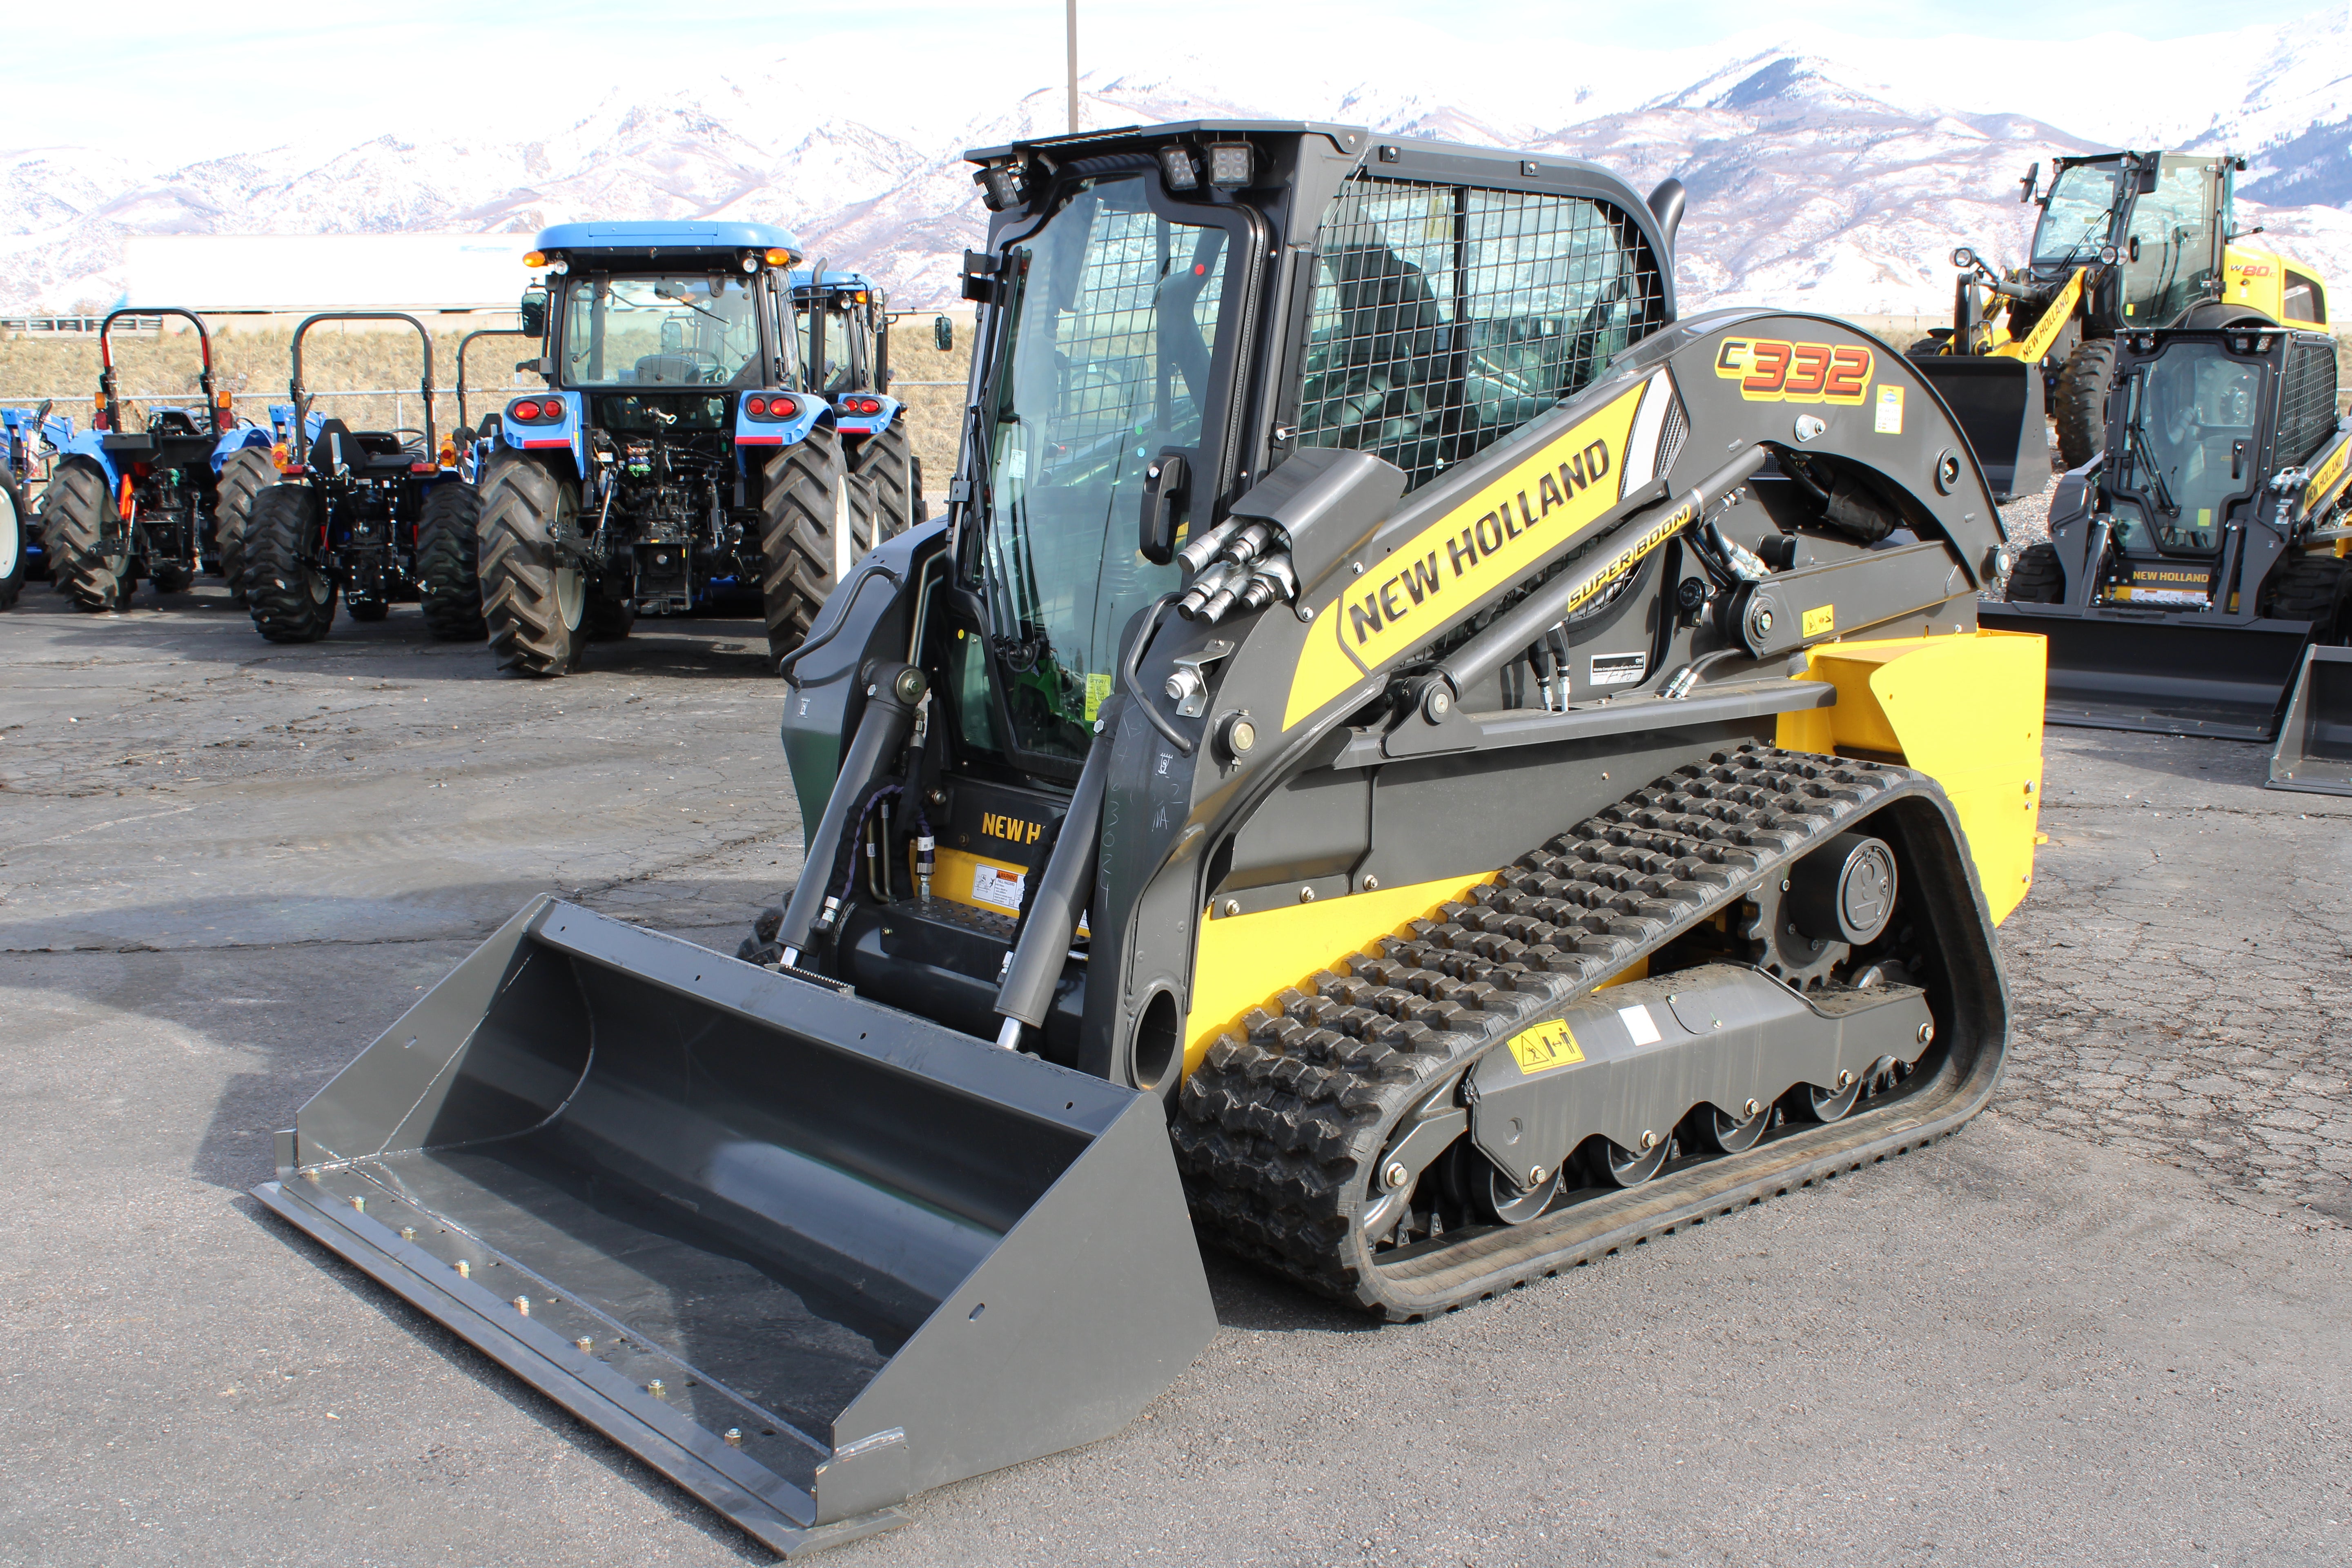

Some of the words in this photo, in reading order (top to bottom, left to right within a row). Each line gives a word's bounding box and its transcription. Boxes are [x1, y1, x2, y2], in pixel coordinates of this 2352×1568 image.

[2022, 332, 2038, 361] NEW
[2039, 291, 2069, 339] HOLLAND
[1716, 339, 1872, 399] C332
[2306, 481, 2318, 506] NEW
[2319, 453, 2342, 490] HOLLAND
[1348, 549, 1440, 646] NEW
[1446, 438, 1610, 579] HOLLAND
[1568, 549, 1633, 611] SUPER
[1635, 505, 1690, 559] BOOM
[2133, 571, 2158, 580] NEW
[2159, 572, 2209, 583] HOLLAND
[982, 812, 1025, 842] NEW
[1000, 872, 1017, 881] WARNING
